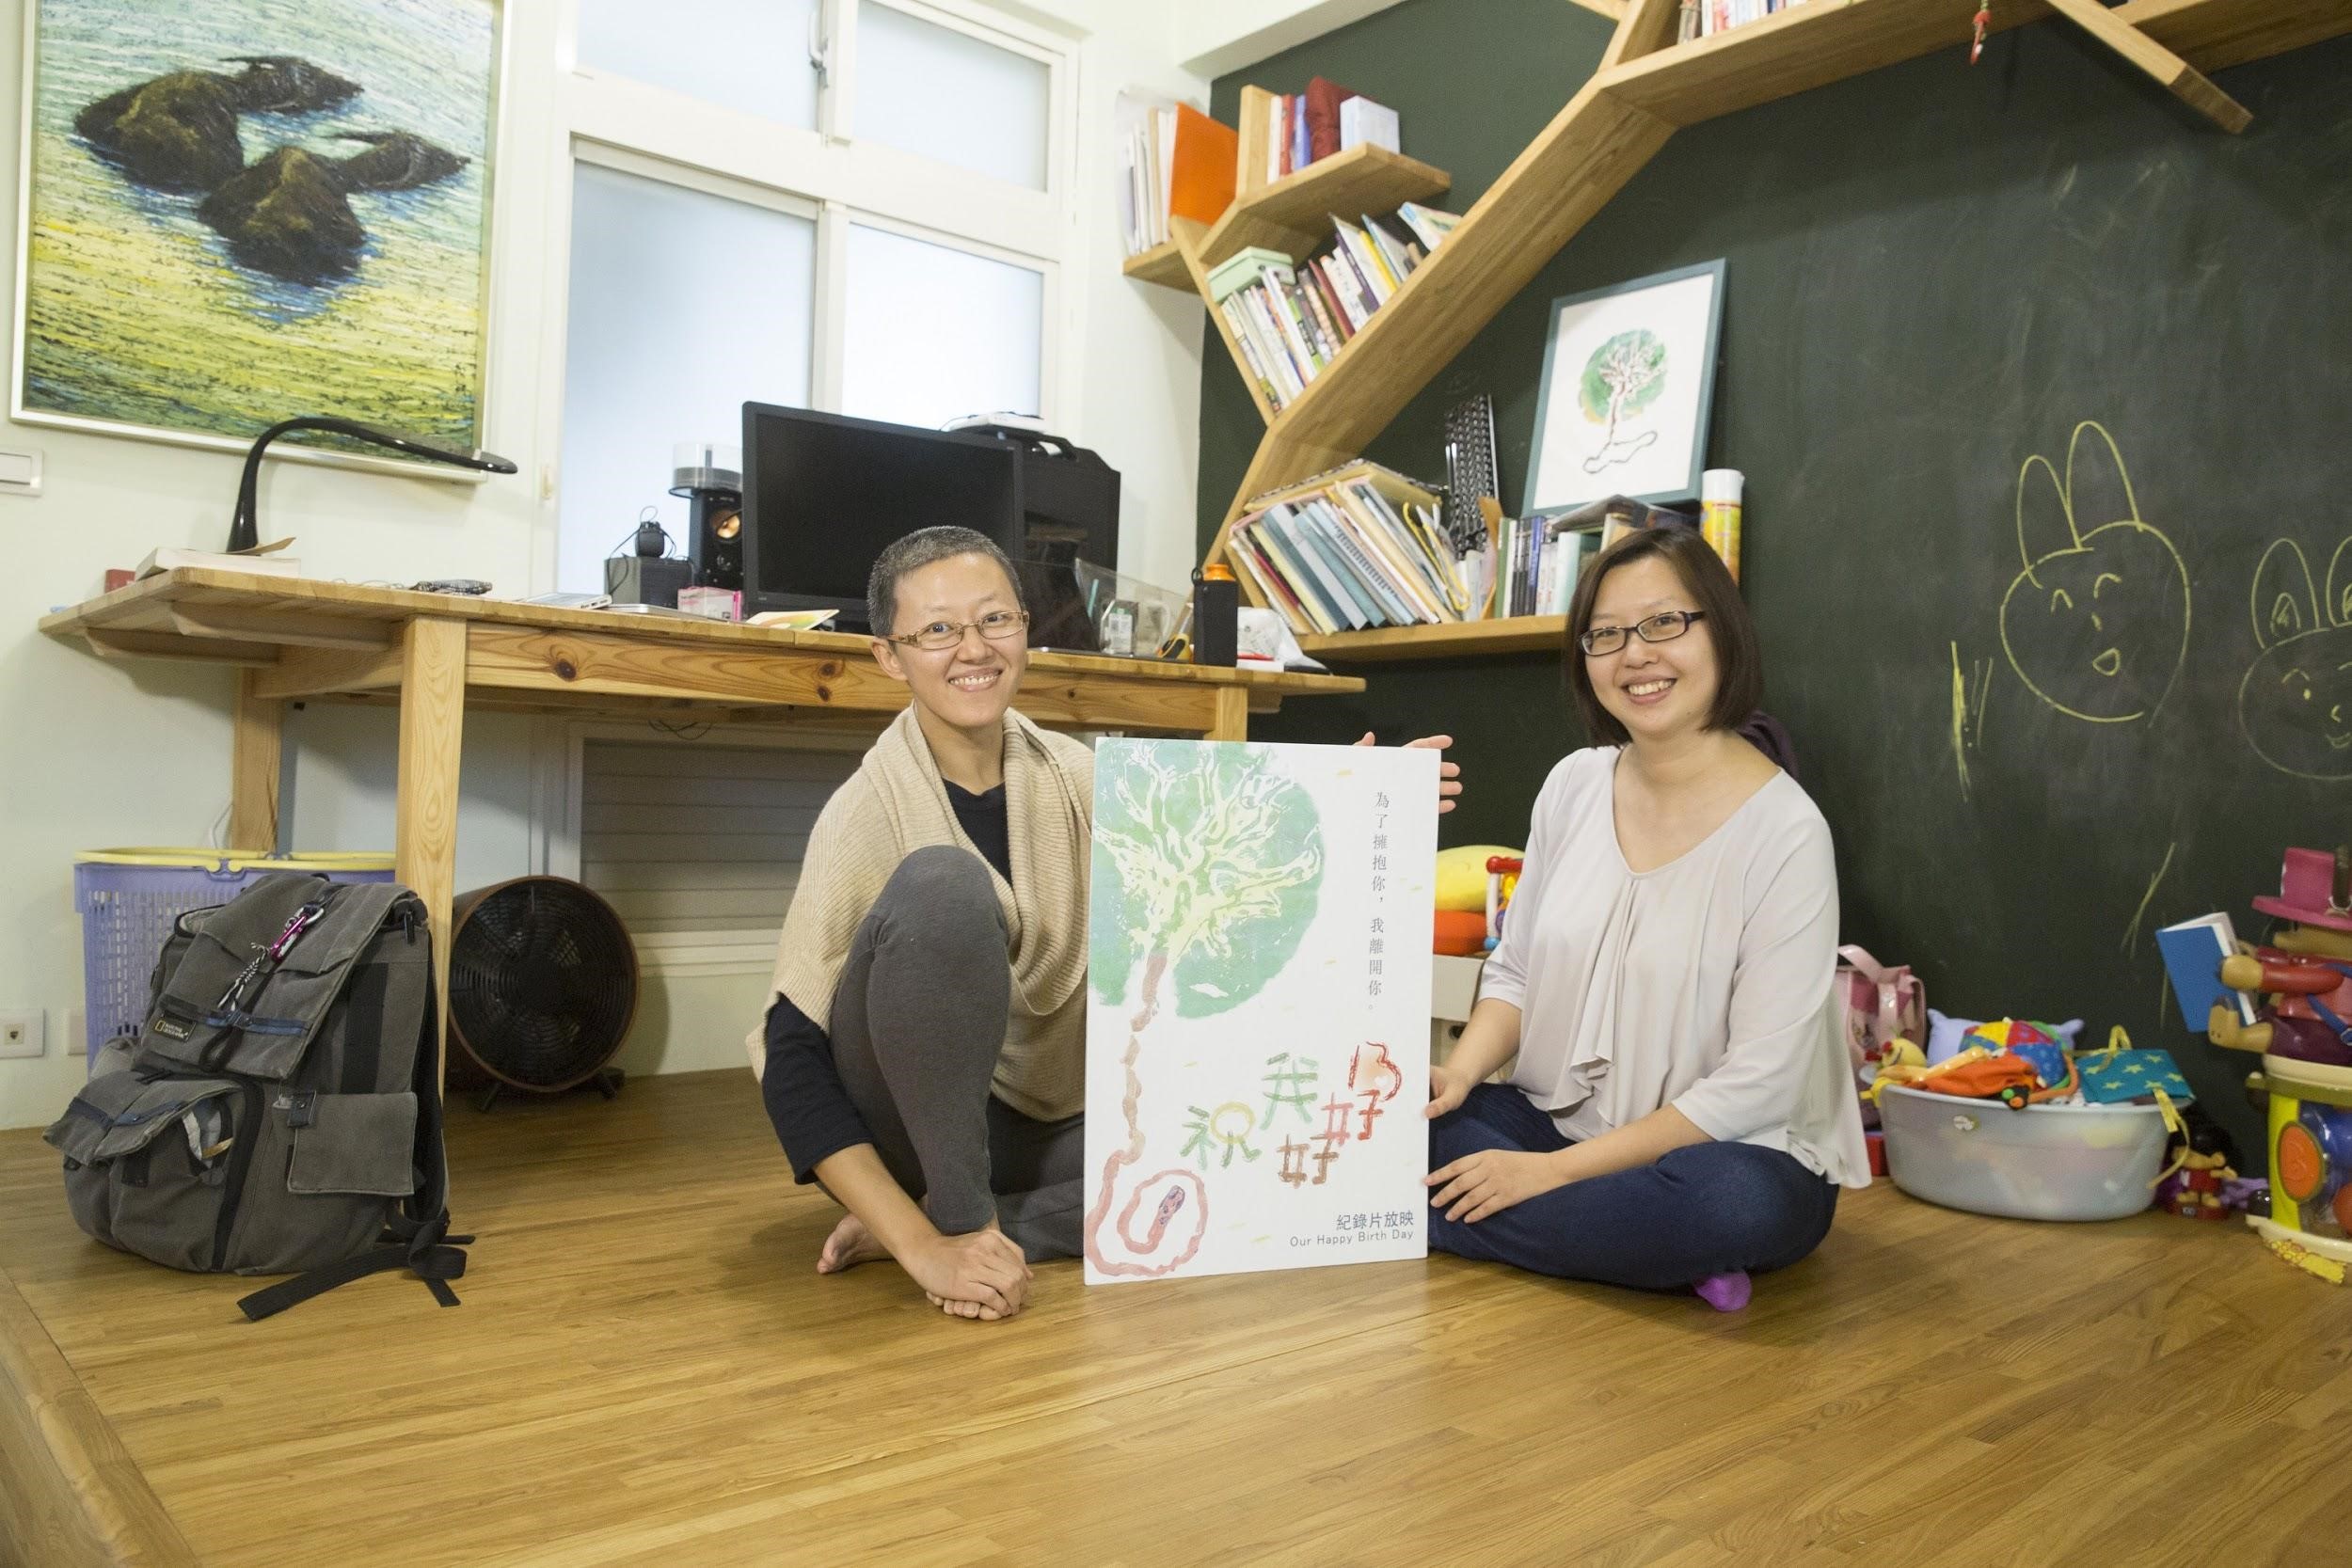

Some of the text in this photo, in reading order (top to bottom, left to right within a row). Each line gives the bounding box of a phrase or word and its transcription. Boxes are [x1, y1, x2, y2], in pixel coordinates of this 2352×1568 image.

[1337, 1211, 1414, 1230] 紀錄片放映
[1290, 1228, 1414, 1246] Our Happy Birth Day
